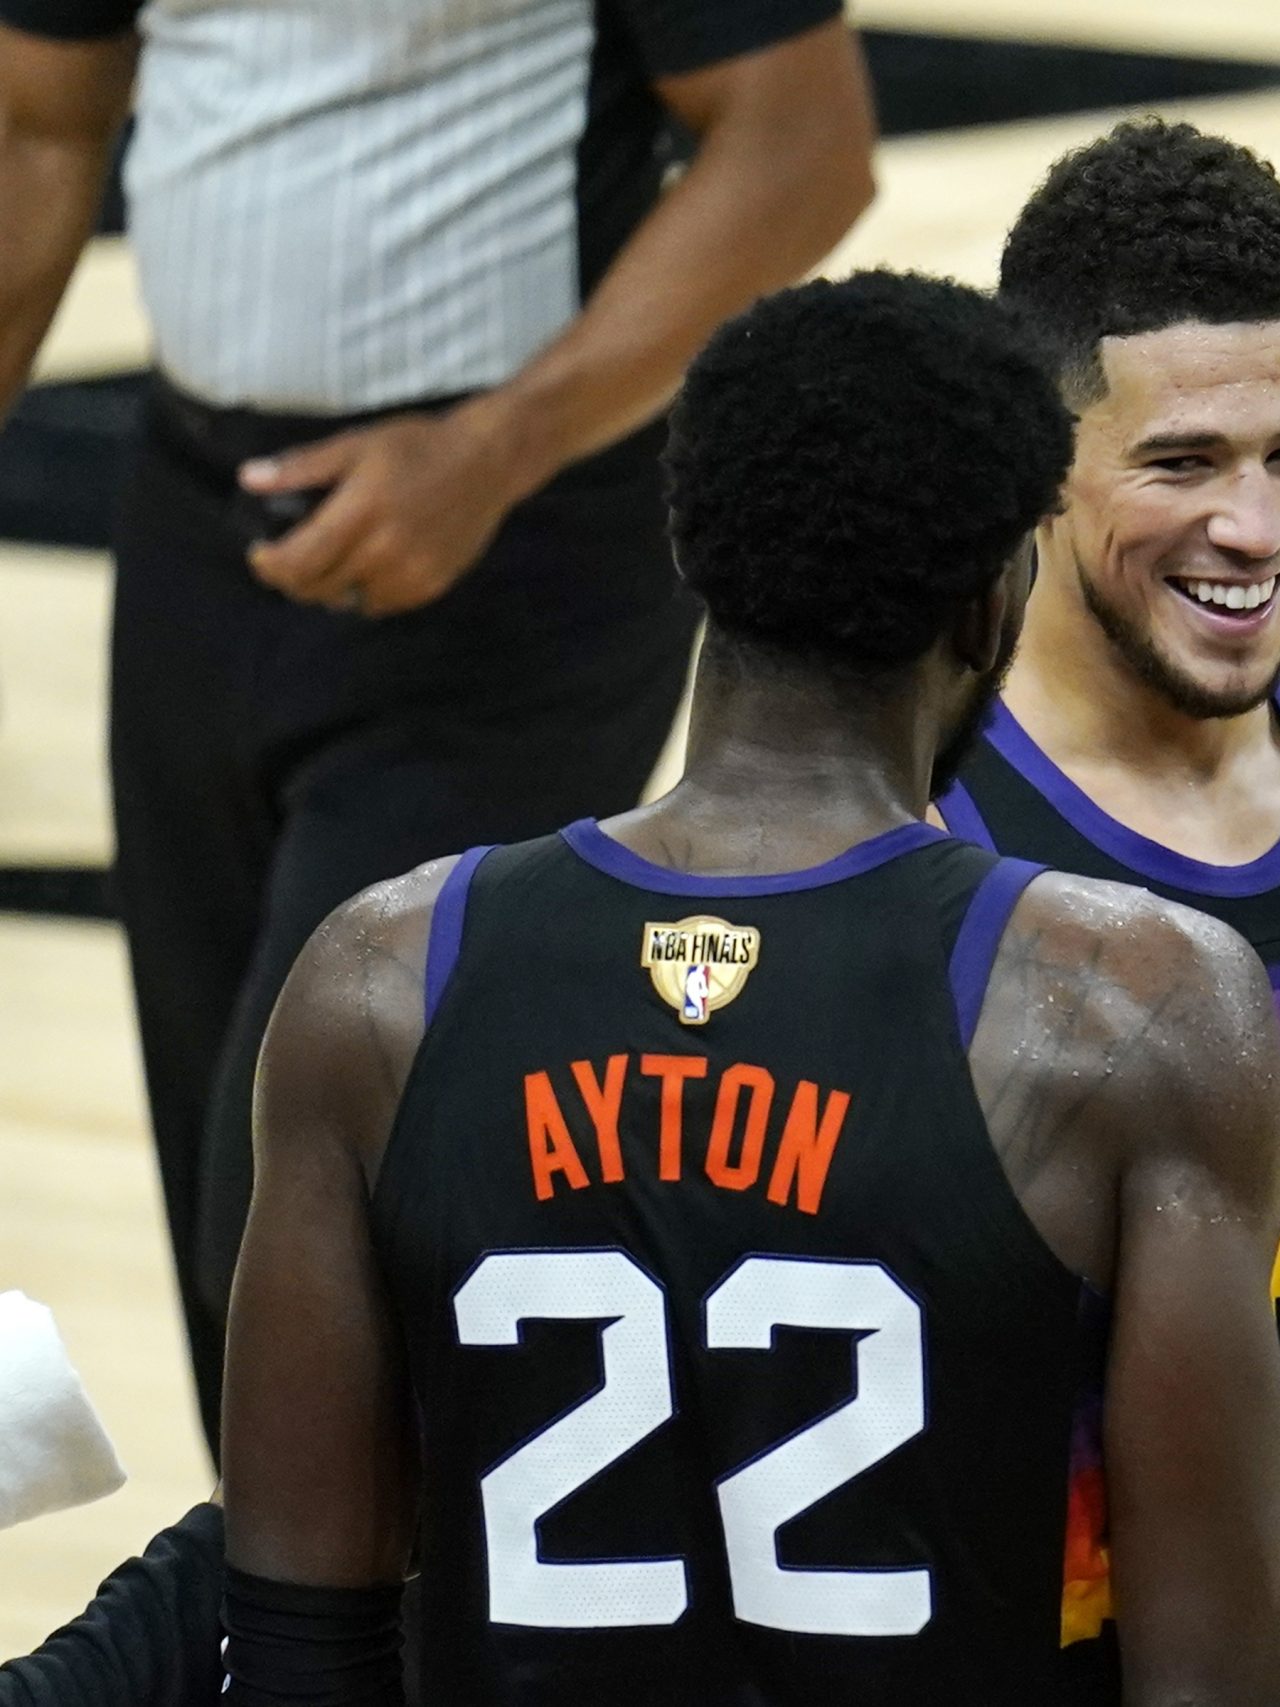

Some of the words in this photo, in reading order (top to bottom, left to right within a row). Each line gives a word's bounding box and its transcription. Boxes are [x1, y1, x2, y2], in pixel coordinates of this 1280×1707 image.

[651, 931, 687, 962] NBA
[690, 933, 752, 964] FINALS
[524, 1053, 851, 1216] AYTON
[452, 1249, 933, 1637] 22
